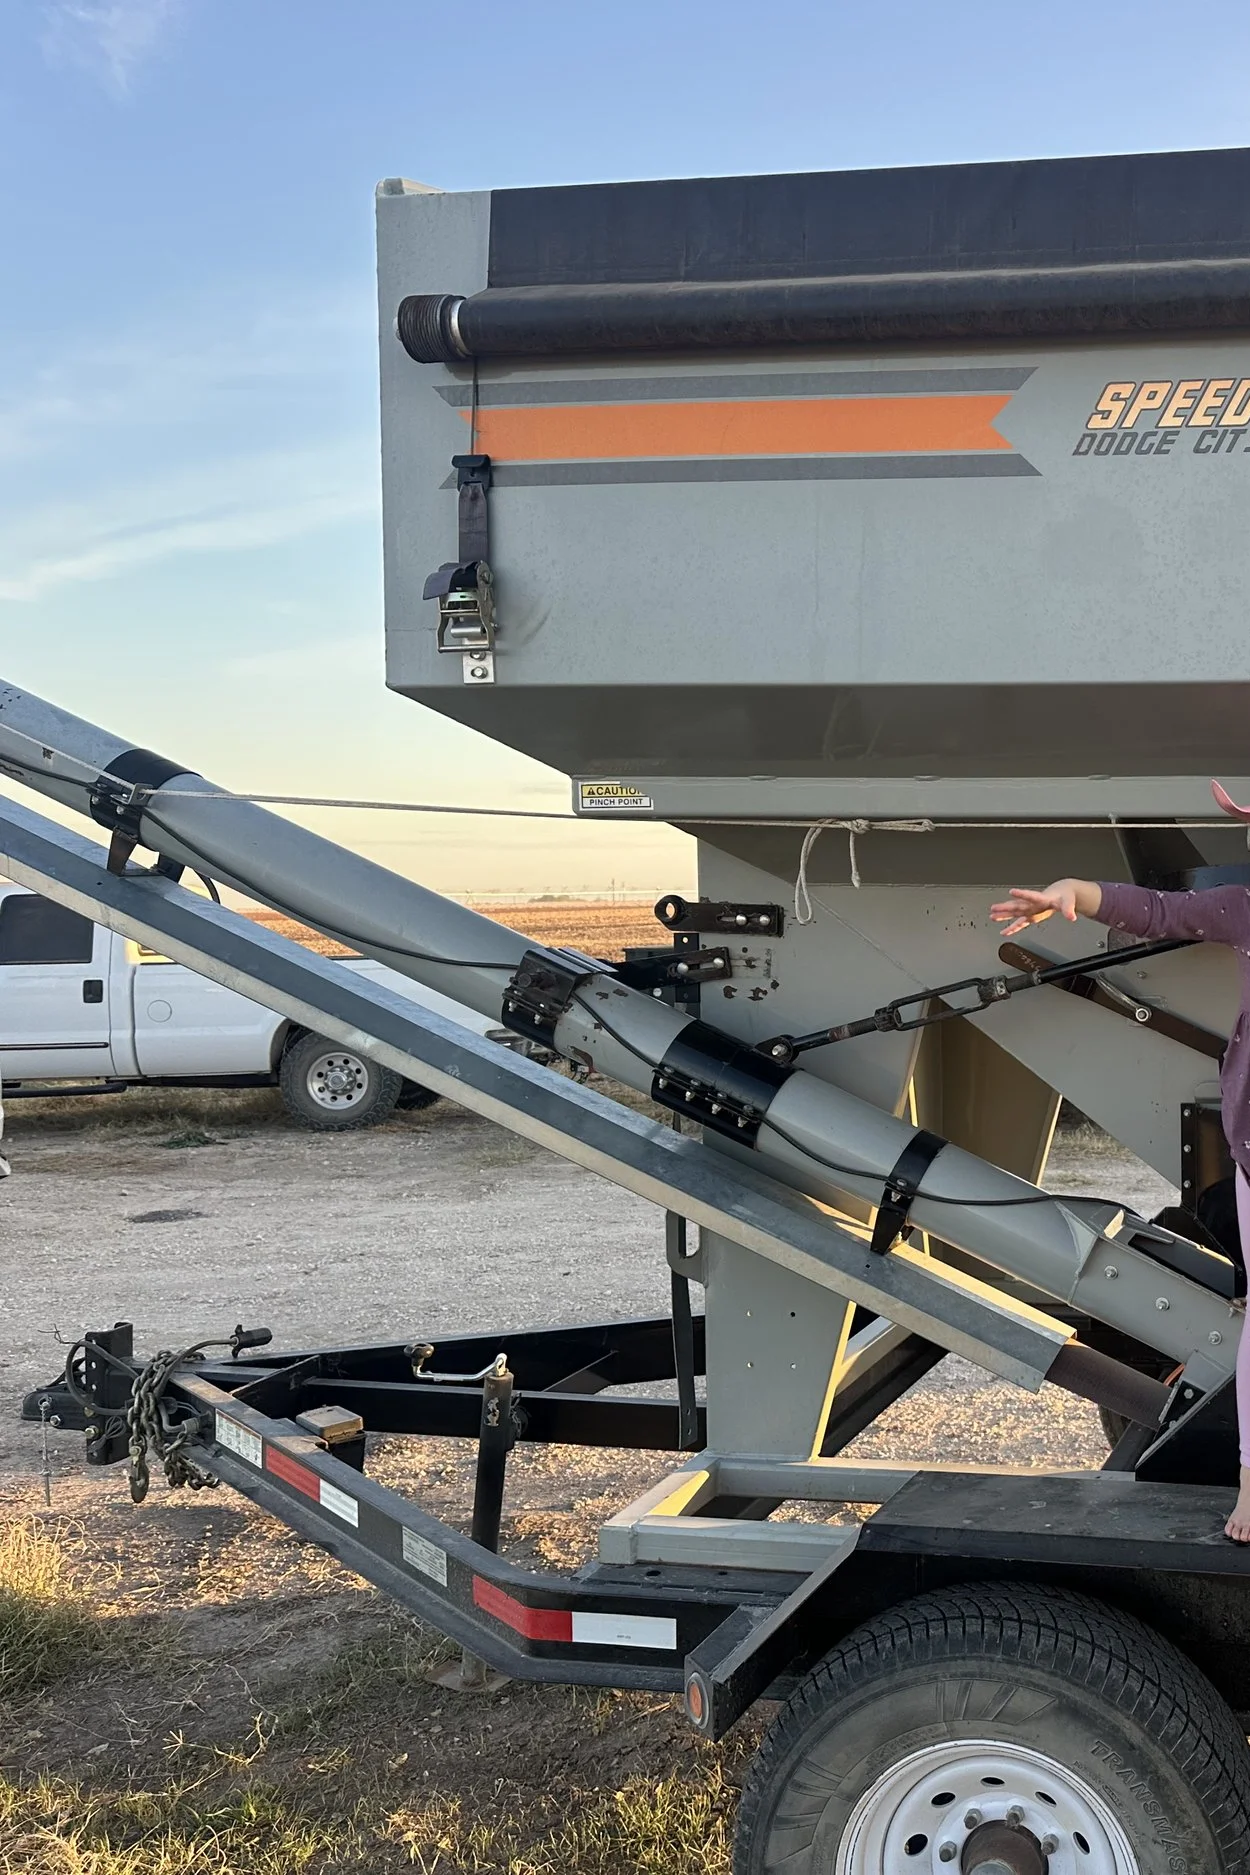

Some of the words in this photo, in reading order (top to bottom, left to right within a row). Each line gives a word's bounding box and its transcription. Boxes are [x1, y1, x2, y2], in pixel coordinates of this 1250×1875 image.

[1072, 430, 1176, 456] DODGE
[618, 798, 643, 806] POINT
[1090, 1740, 1188, 1875] TRANSMAS
